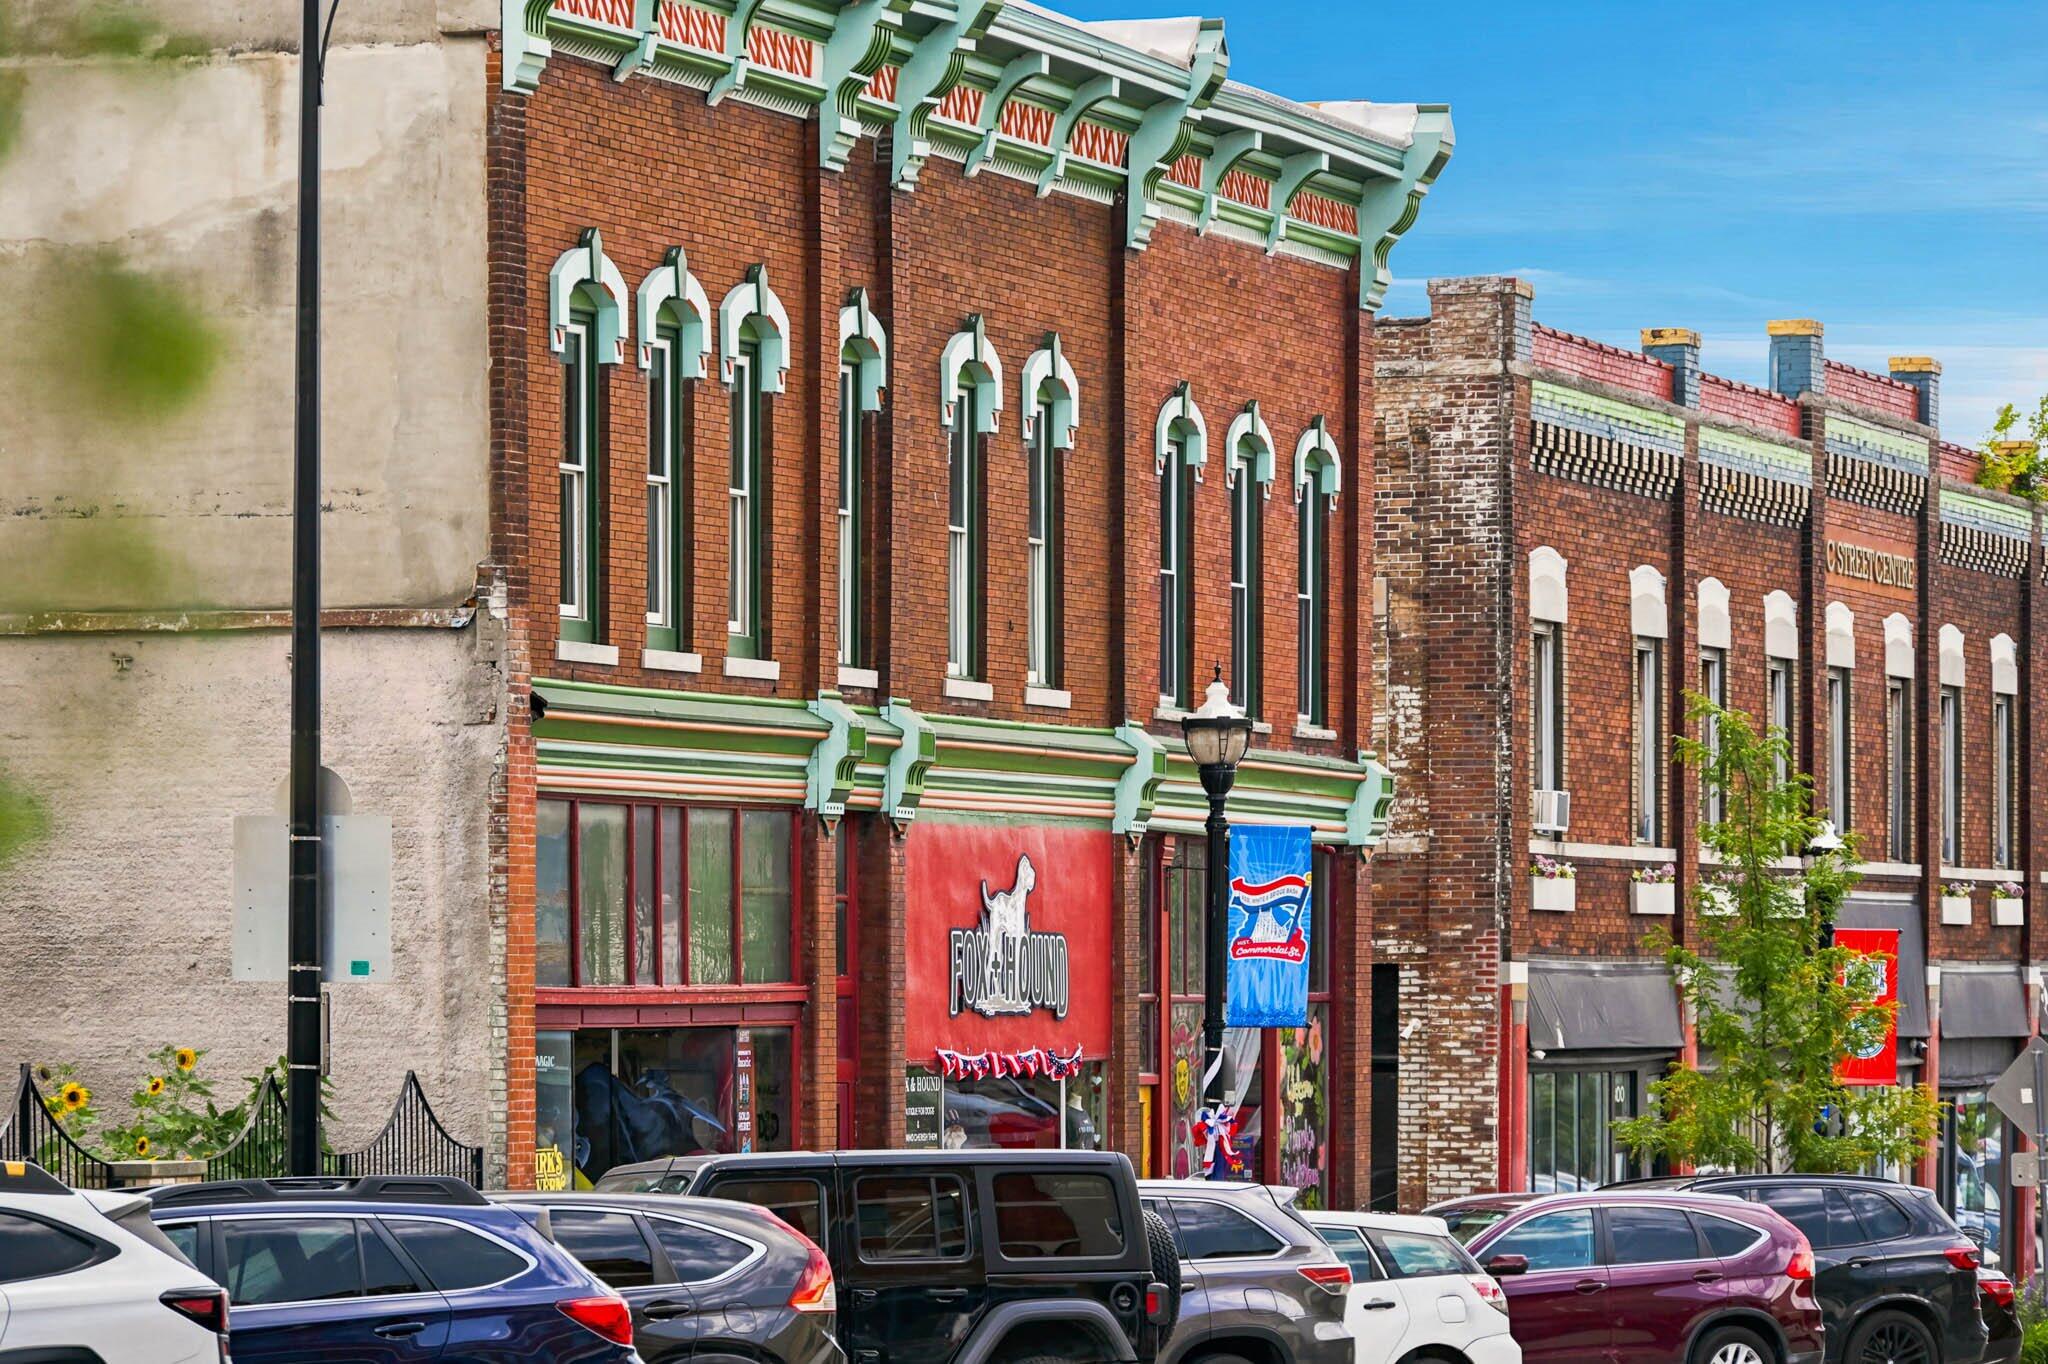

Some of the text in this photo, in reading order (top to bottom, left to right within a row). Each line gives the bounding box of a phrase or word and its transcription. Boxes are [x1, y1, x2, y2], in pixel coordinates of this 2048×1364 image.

[1827, 540, 1915, 589] C STREET CENTRE
[1236, 946, 1301, 957] Commercial St.
[950, 930, 989, 1015] FOX
[1004, 933, 1069, 1017] HOUND
[910, 1077, 916, 1092] &
[916, 1076, 940, 1092] HOUND
